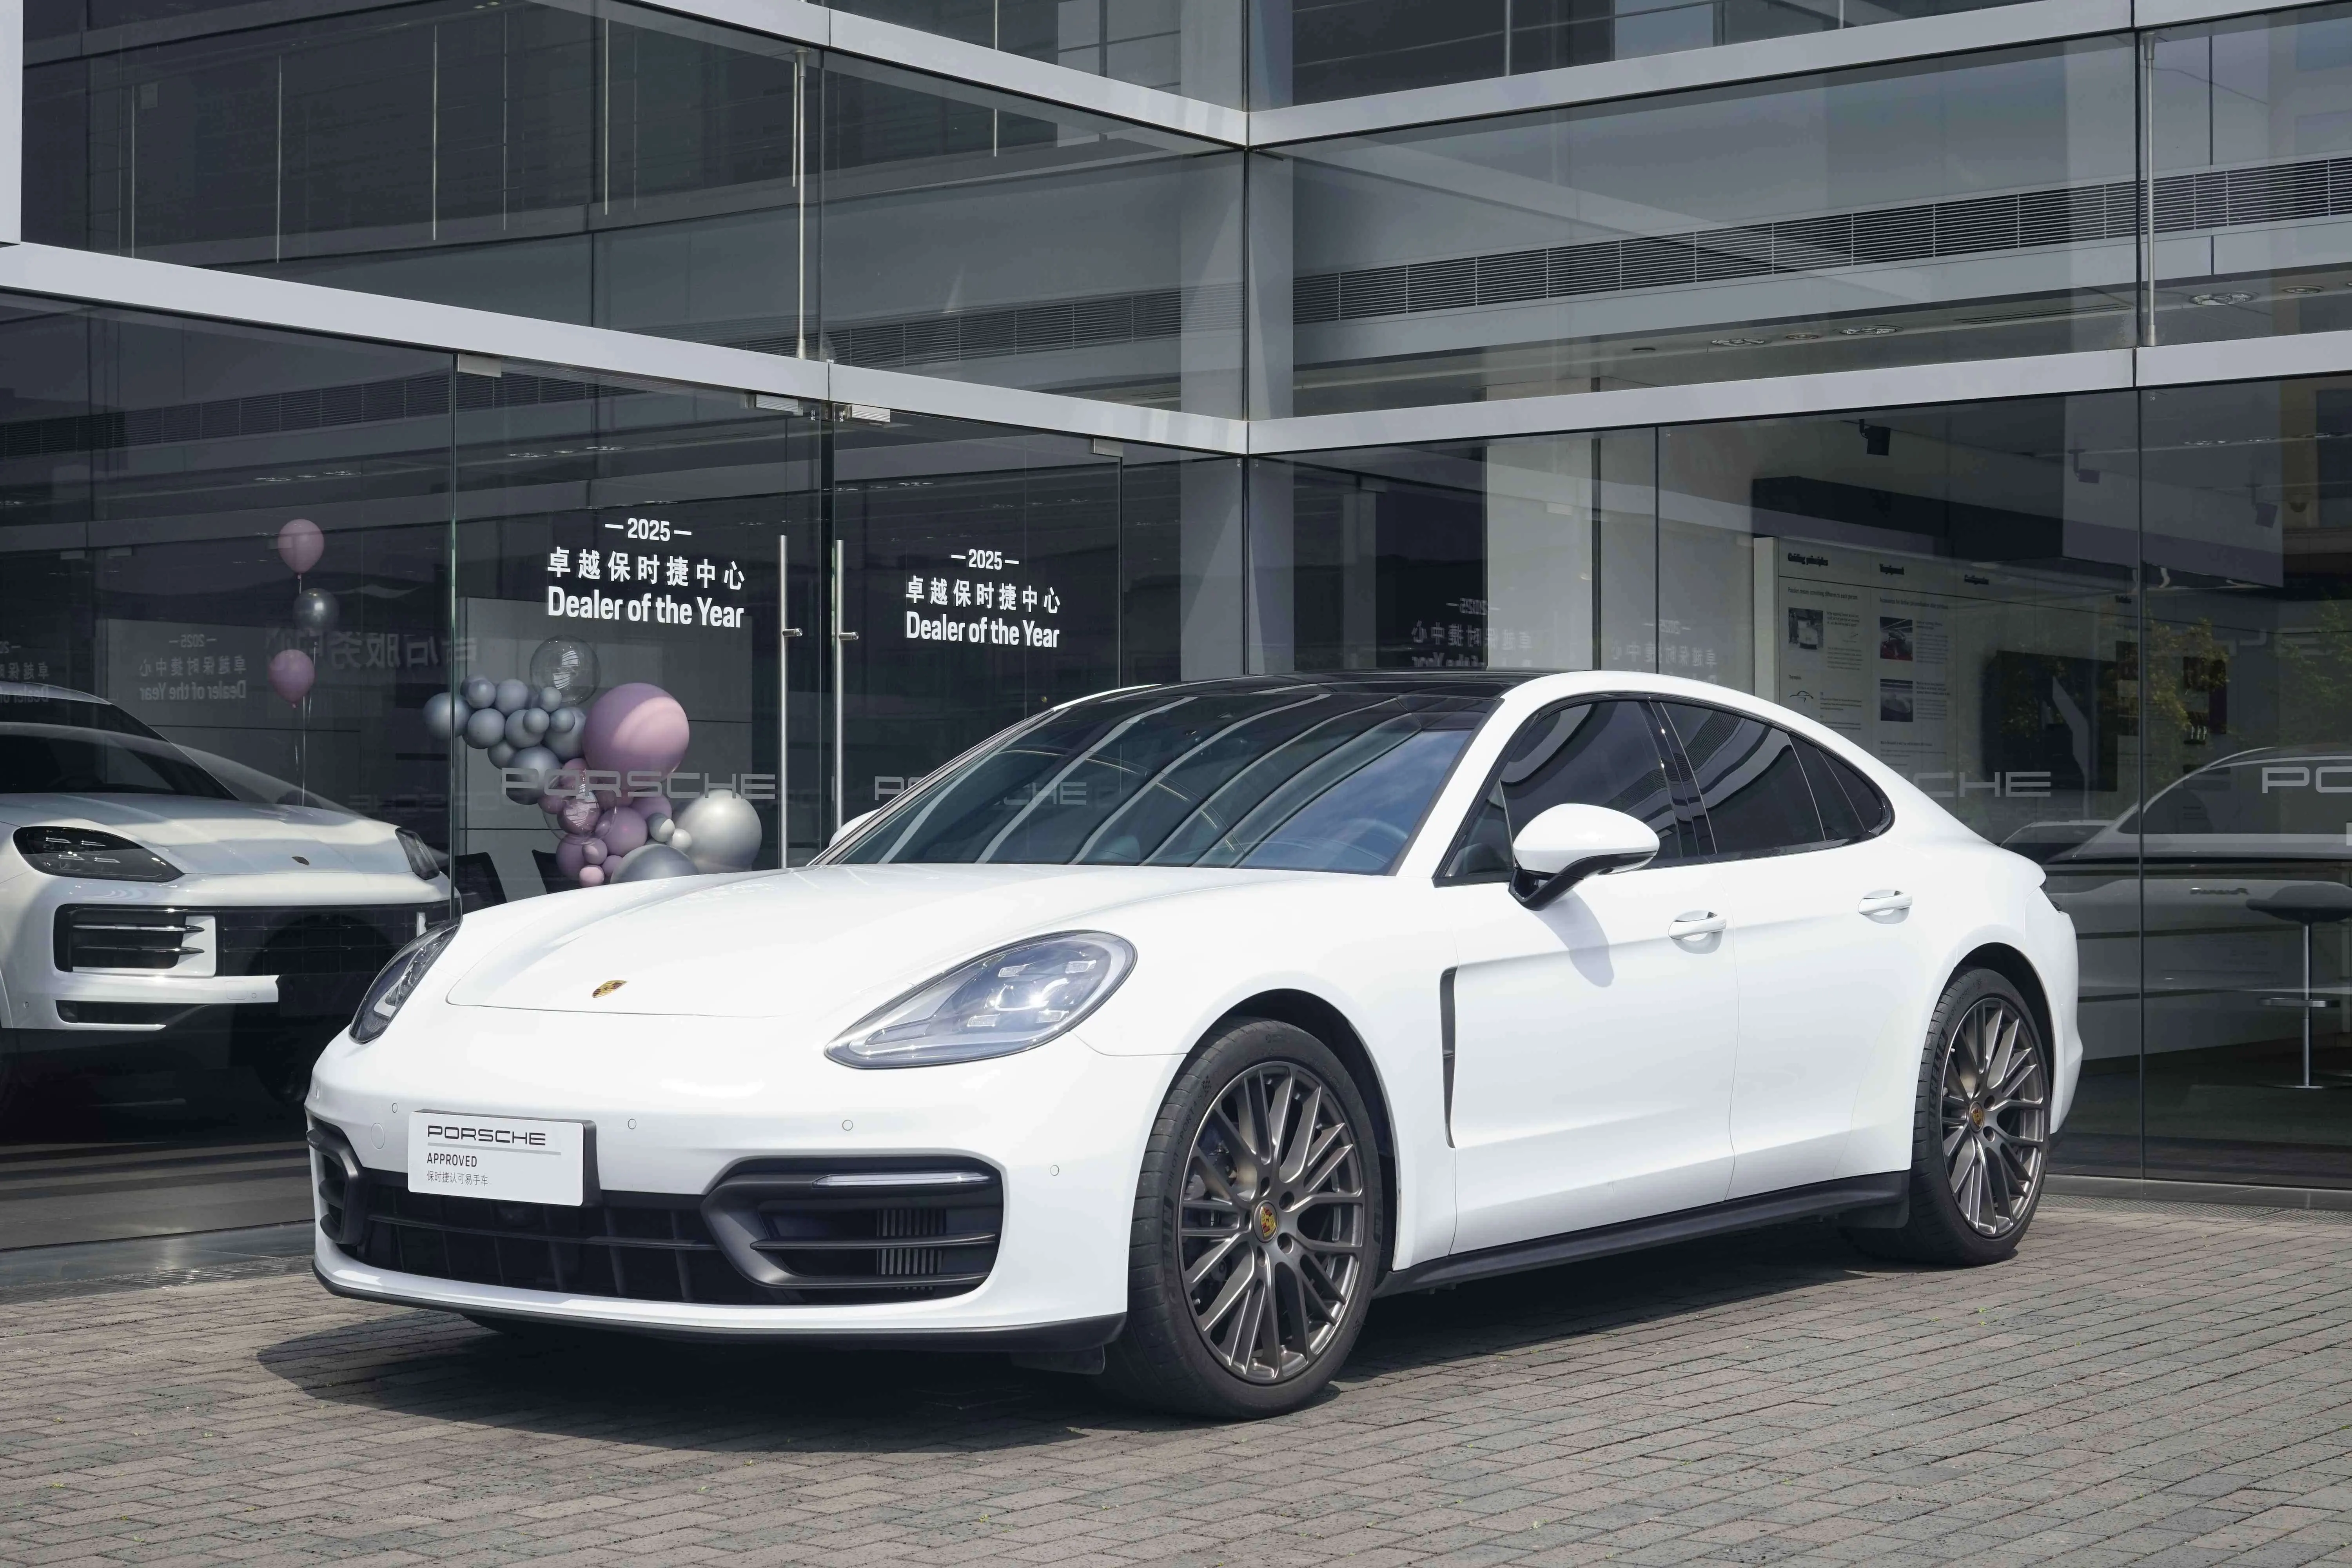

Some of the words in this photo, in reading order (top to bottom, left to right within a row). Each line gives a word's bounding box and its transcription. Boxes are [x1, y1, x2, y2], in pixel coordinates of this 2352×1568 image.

[548, 547, 744, 590] 卓越保时捷中心
[548, 586, 622, 620] Dealer
[628, 593, 651, 621] of
[656, 595, 692, 624] the
[697, 597, 744, 628] Year
[906, 575, 1060, 613] 卓越保时捷中心
[907, 611, 965, 641] Dealer
[969, 617, 987, 643] of
[991, 618, 1019, 645] the
[1023, 620, 1059, 647] Year
[501, 768, 775, 800] PORSCHE
[428, 1125, 546, 1145] PORSCHE
[427, 1152, 477, 1167] APPROVED
[426, 1171, 488, 1186] 保时捷认可易手车
